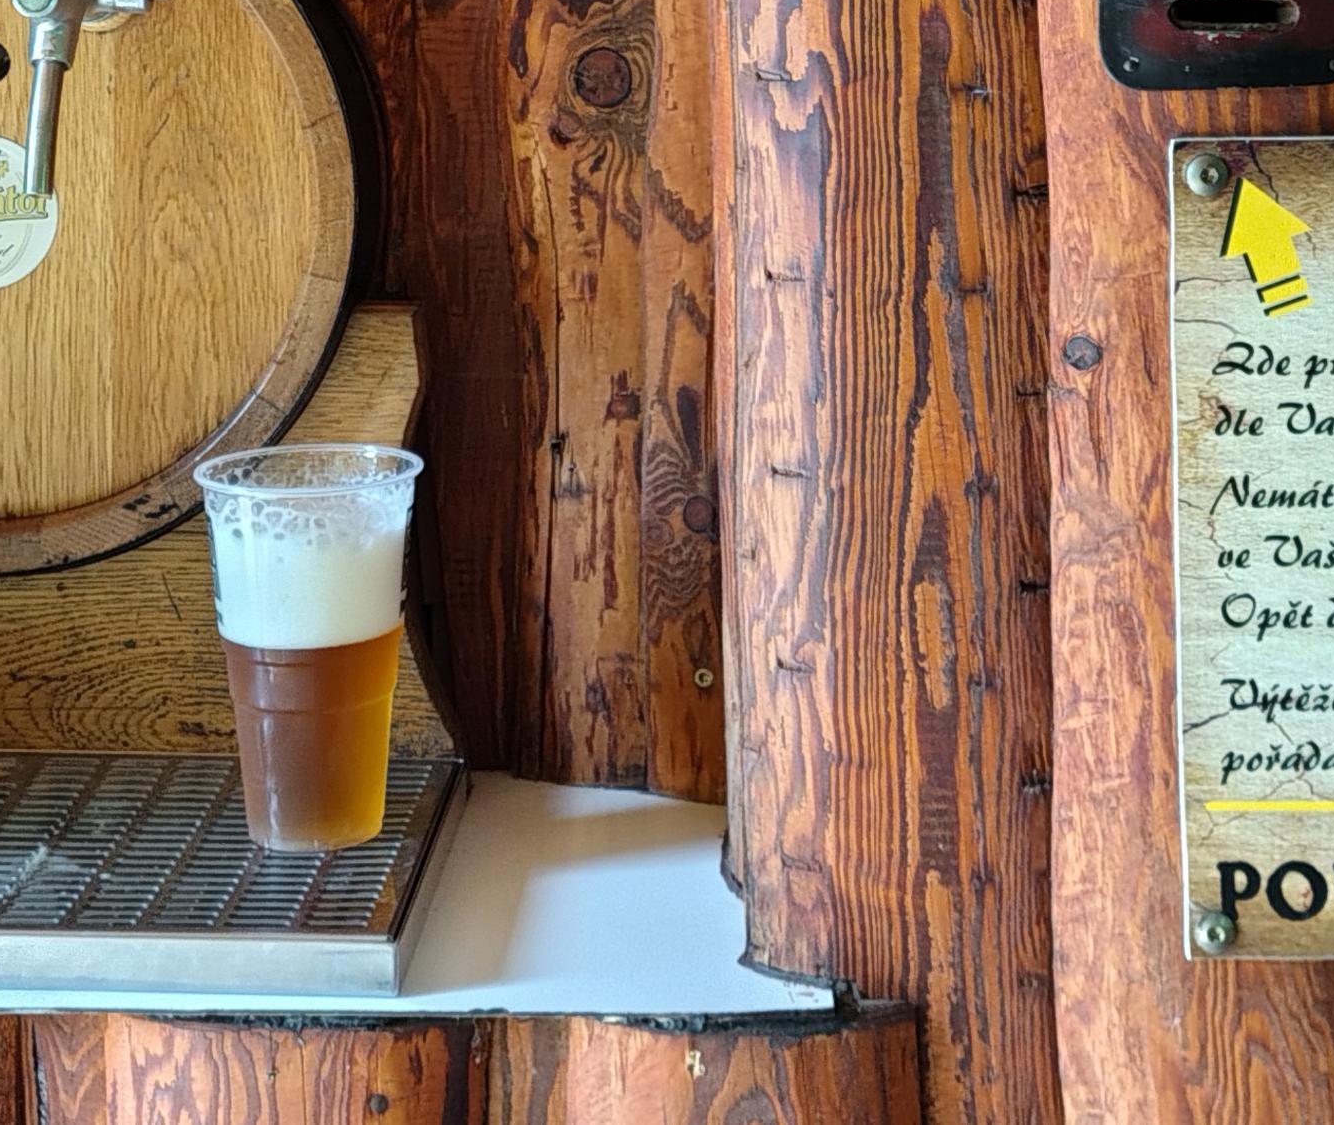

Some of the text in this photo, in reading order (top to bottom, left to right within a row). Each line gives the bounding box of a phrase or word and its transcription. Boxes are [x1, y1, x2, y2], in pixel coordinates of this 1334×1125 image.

[1212, 341, 1291, 377] Zde
[1214, 404, 1264, 437] dle
[1216, 547, 1251, 569] ve
[1220, 593, 1313, 641] Opět
